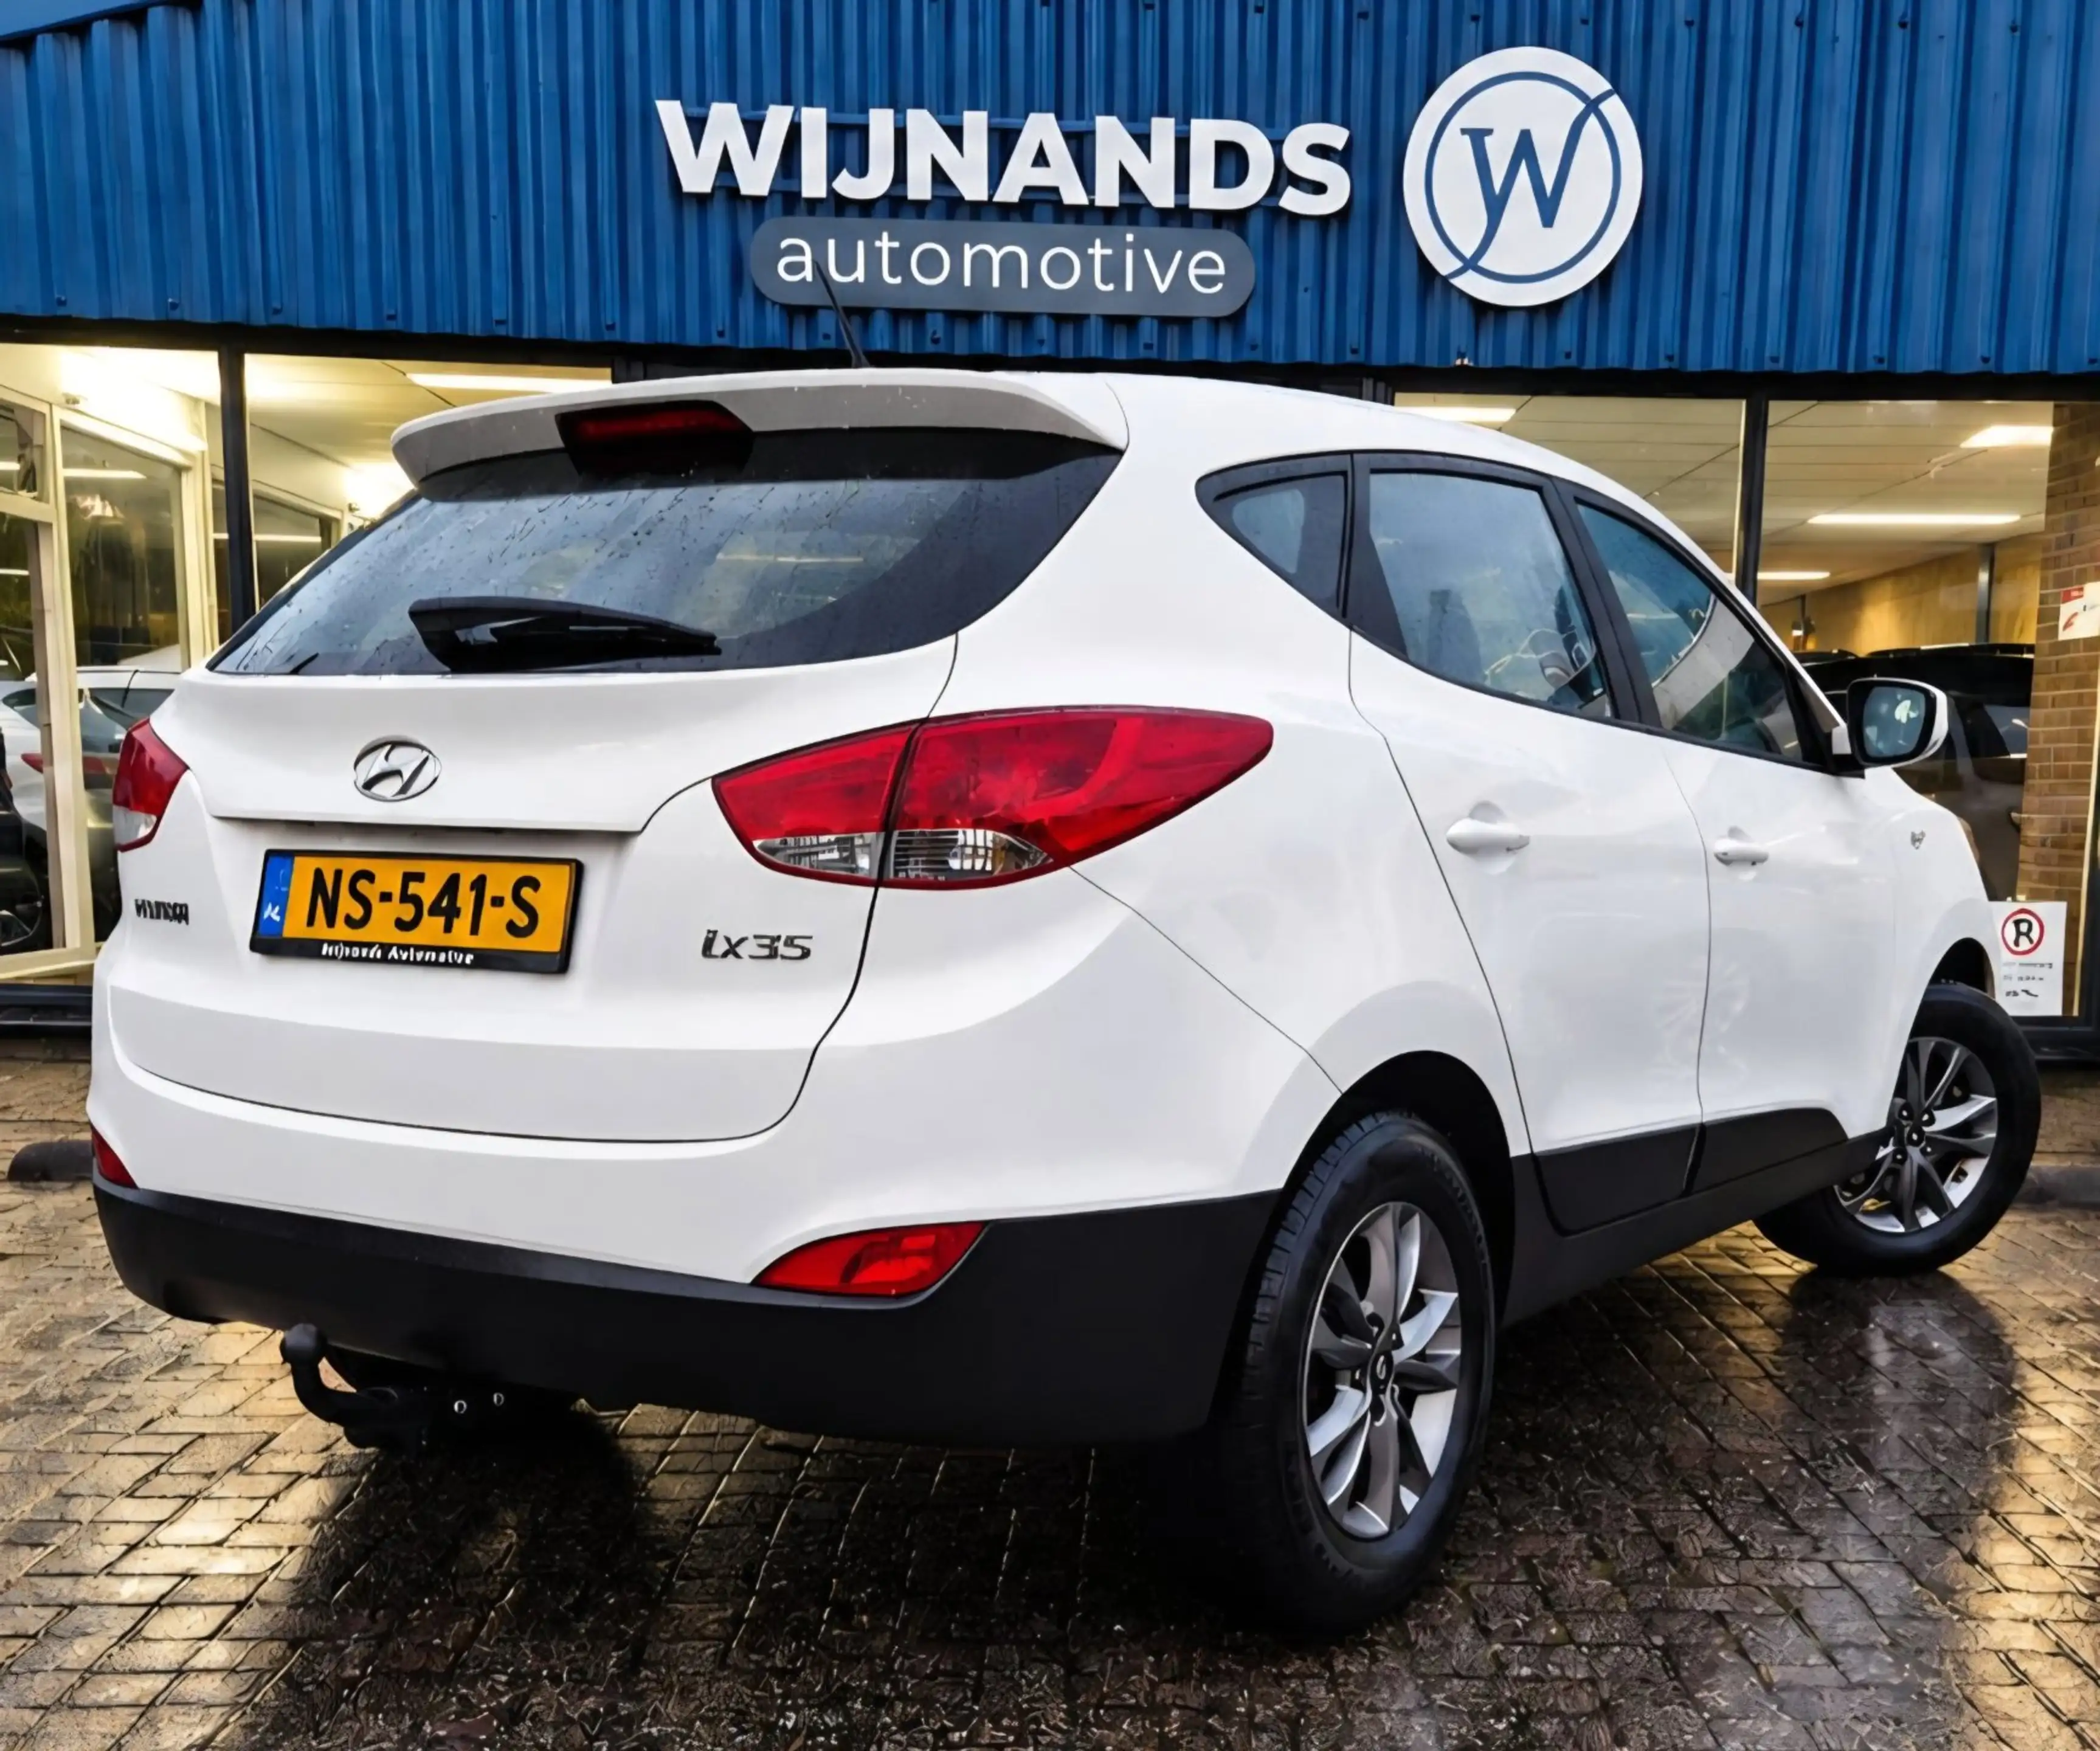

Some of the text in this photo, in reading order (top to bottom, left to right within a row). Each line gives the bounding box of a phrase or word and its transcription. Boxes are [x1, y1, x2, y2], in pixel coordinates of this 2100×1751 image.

[655, 100, 1351, 215] WIJNANDS
[777, 232, 1226, 294] automotive
[306, 867, 542, 939] NS-541-S
[2012, 917, 2034, 948] R
[702, 928, 813, 961] ix35
